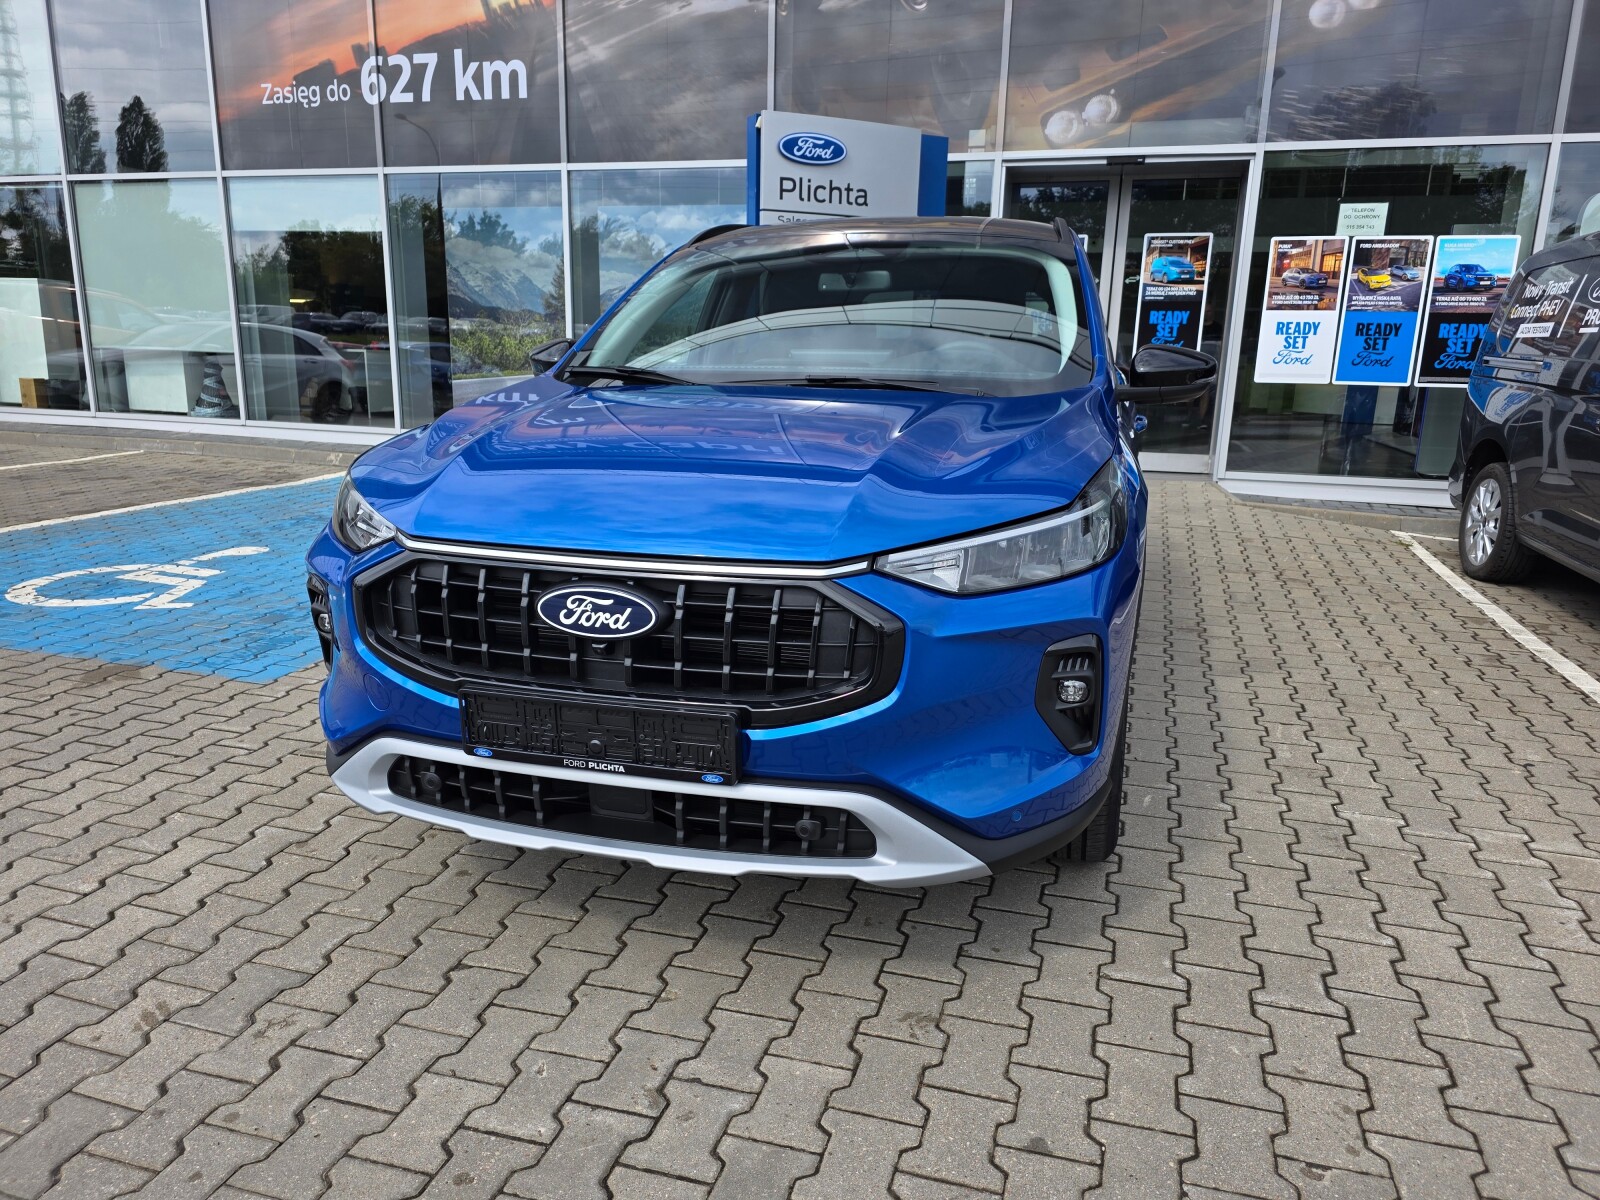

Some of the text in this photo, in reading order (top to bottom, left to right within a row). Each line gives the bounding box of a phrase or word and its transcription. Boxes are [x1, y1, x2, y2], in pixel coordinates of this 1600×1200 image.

[260, 48, 528, 108] Zasięg do 627 km
[794, 137, 835, 160] Ford
[779, 176, 868, 206] Plichta
[1522, 284, 1546, 300] Nowy
[1511, 300, 1565, 318] Connect PHEV
[1149, 311, 1190, 324] READY
[1156, 324, 1179, 337] SET
[1275, 322, 1320, 335] READY
[1355, 322, 1402, 337] READY
[1438, 324, 1488, 338] READY
[1283, 336, 1308, 349] SET
[1363, 337, 1390, 350] SET
[1446, 339, 1475, 353] SET
[1272, 350, 1313, 365] Ford
[1352, 351, 1394, 367] Ford
[559, 594, 632, 630] Ford
[564, 759, 625, 773] FORD PLICHTA
